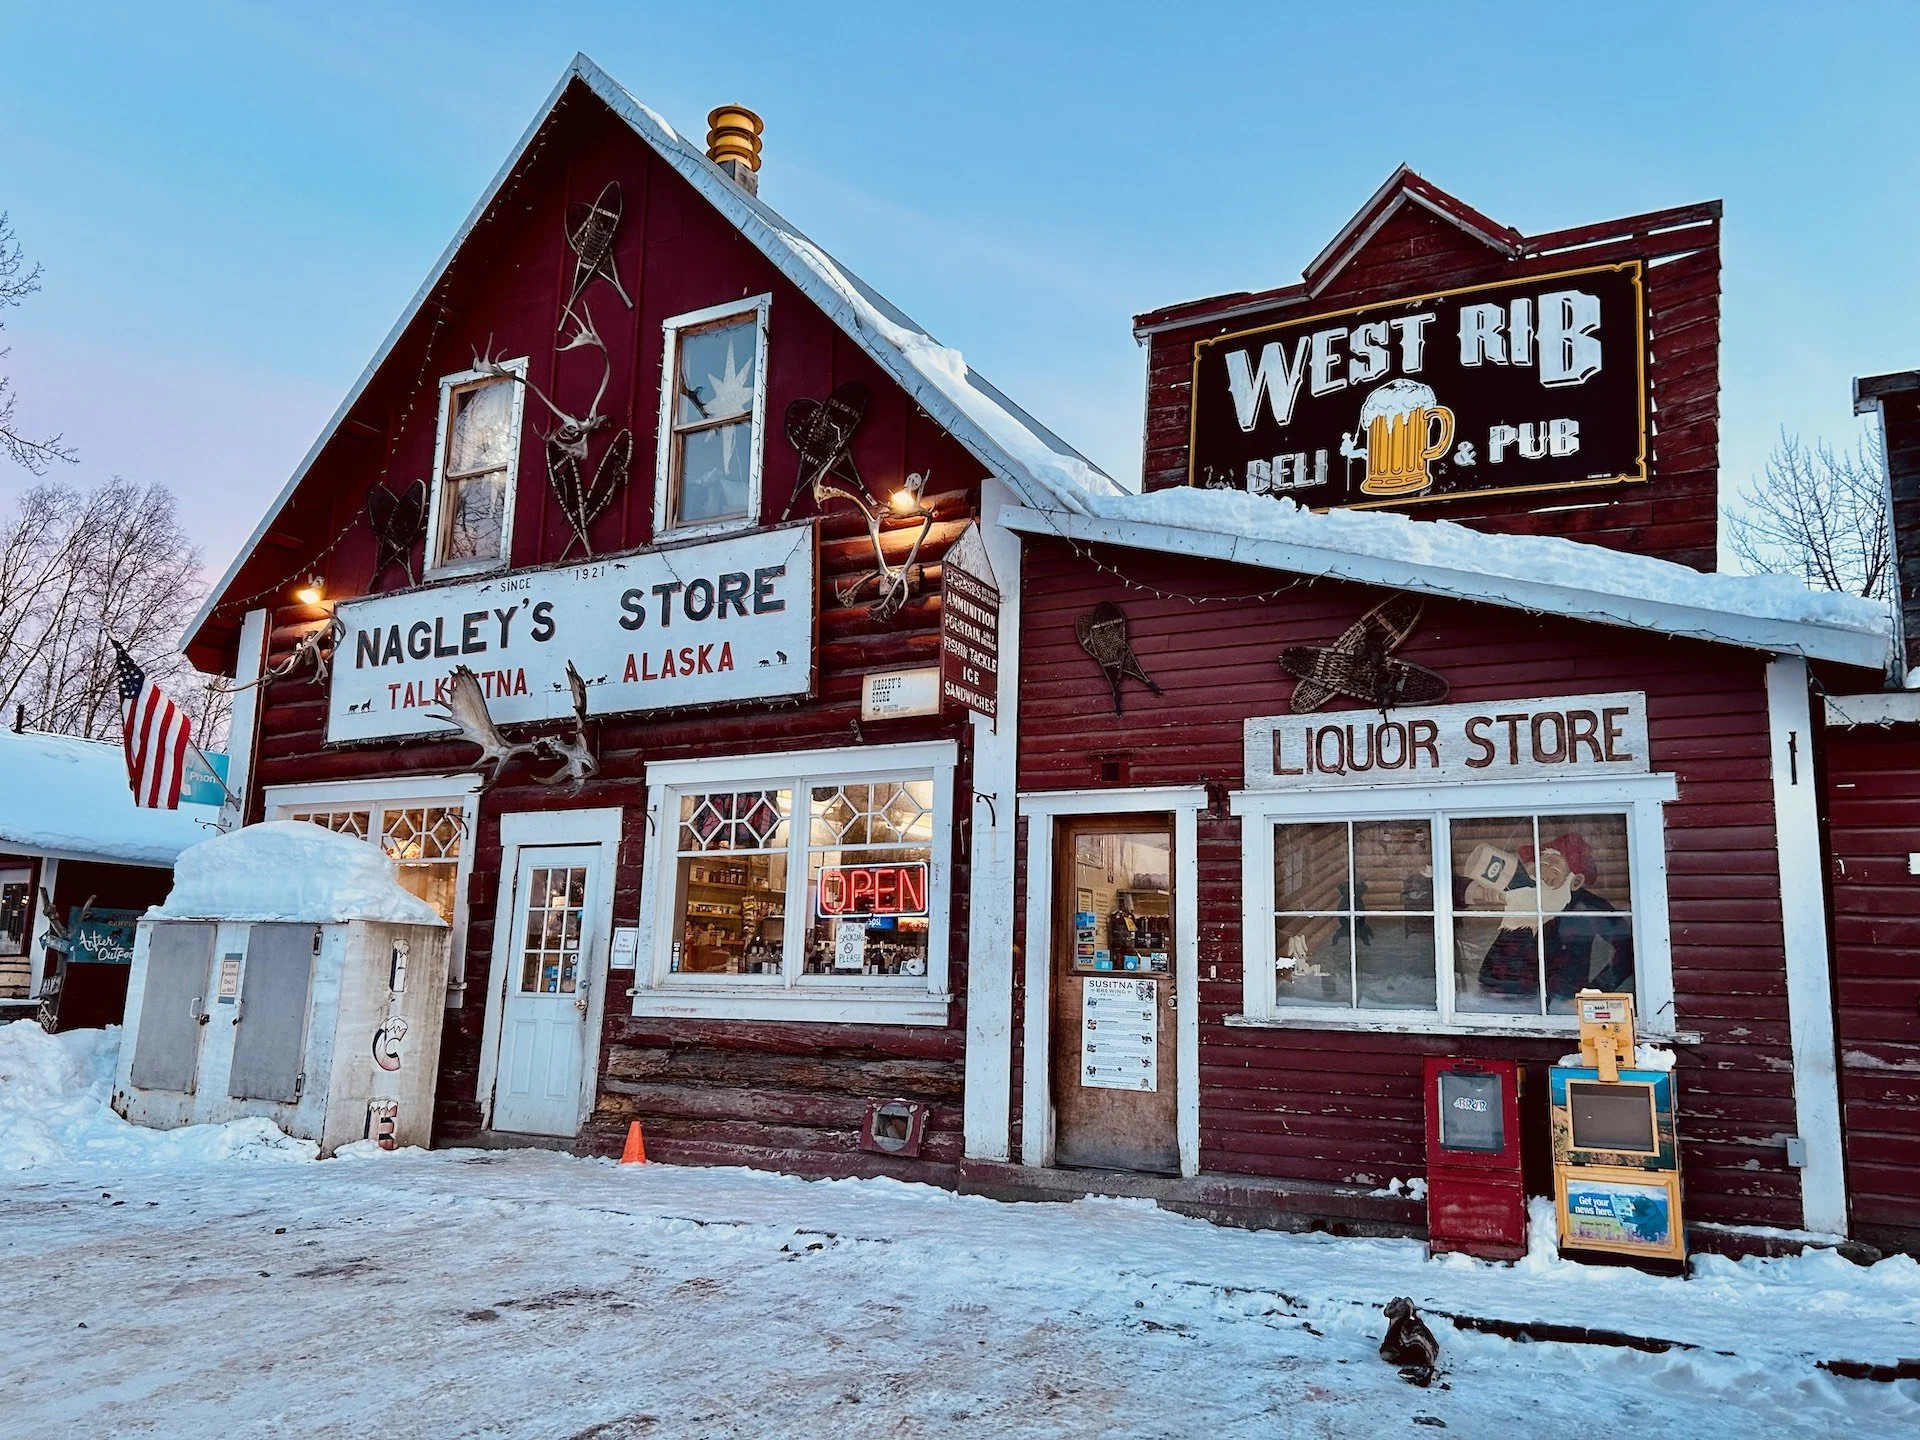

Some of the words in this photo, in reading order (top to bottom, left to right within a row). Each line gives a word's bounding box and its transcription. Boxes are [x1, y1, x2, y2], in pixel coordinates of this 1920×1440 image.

[1224, 312, 1436, 432] WEST
[1456, 289, 1602, 388] RIB
[1246, 449, 1328, 493] DELI
[1453, 441, 1477, 466] &
[1488, 418, 1580, 464] PUB
[575, 565, 605, 580] 1921
[355, 598, 557, 669] NAGLEY'S
[618, 564, 787, 631] STORE
[946, 590, 996, 629] AMMUNITION
[968, 647, 997, 673] TACKLE
[388, 668, 533, 710] TALKTNA,
[622, 641, 735, 684] ALASKA
[872, 677, 902, 691] NAGLEY'S
[963, 665, 980, 686] ICE
[872, 691, 890, 703] STORE
[944, 681, 996, 714] SANDWICHES
[1272, 719, 1440, 776] LIQUOR
[1464, 707, 1634, 768] STORE
[190, 771, 223, 784] Phon
[821, 867, 925, 914] OPEN
[838, 932, 864, 943] SMOKING
[845, 925, 856, 933] NO
[78, 929, 117, 952] Antler
[98, 945, 135, 963] Outpo
[838, 953, 862, 964] PLEASE
[1089, 980, 1134, 989] SUSITNA
[363, 938, 410, 1150] ICE
[1575, 1206, 1595, 1215] news
[1595, 1206, 1615, 1217] here.
[1579, 1196, 1592, 1206] Get
[1592, 1198, 1610, 1208] your
